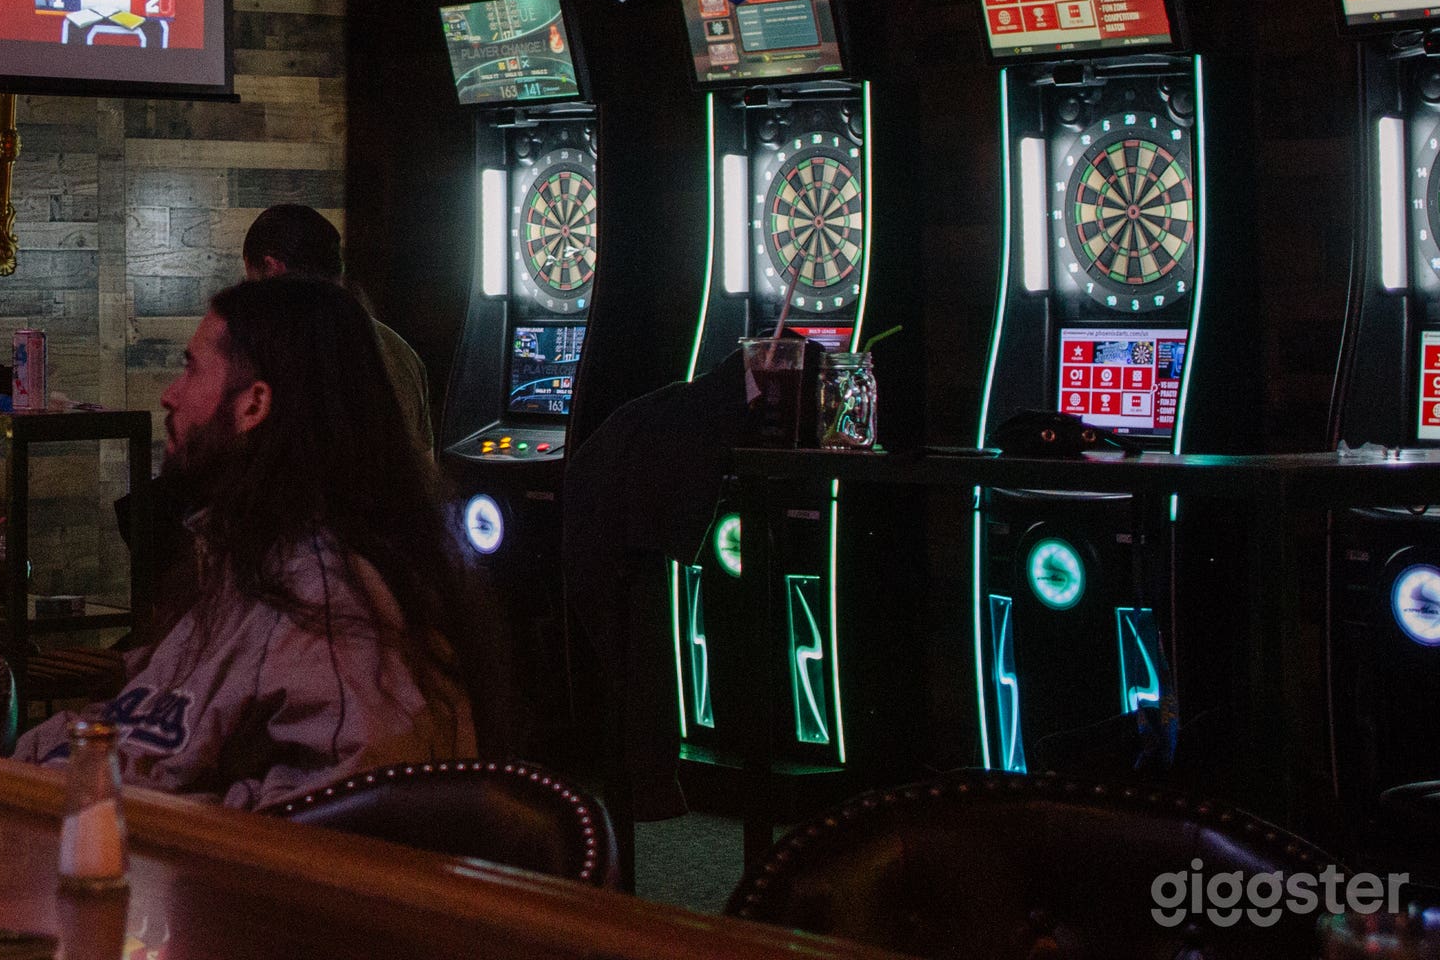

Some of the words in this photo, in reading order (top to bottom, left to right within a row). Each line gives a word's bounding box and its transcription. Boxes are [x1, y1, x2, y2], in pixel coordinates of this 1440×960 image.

[501, 86, 518, 99] 163
[523, 83, 541, 96] 141
[1069, 369, 1083, 380] 01
[548, 400, 564, 412] 163
